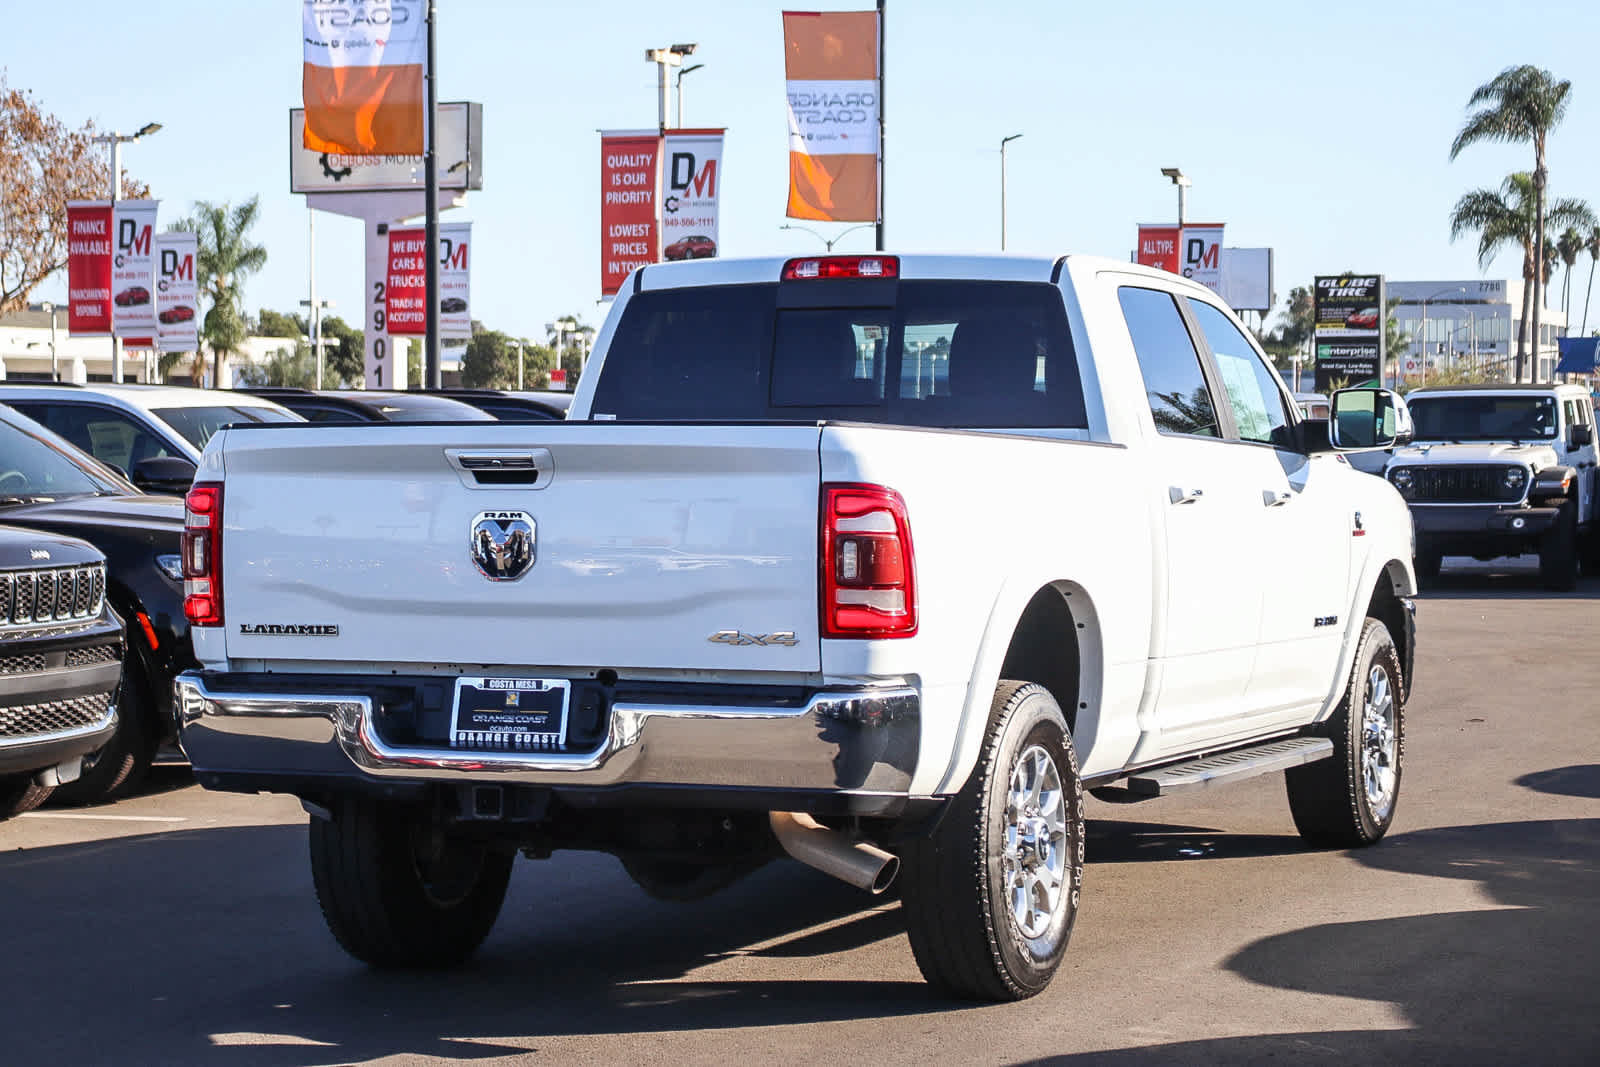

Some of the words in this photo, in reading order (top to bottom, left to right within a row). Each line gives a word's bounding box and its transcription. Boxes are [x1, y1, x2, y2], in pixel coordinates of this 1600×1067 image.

[607, 154, 652, 168] QUALITY
[612, 173, 621, 186] IS
[623, 173, 646, 185] OUR
[671, 152, 717, 198] DM
[606, 192, 652, 205] PRIORITY
[73, 220, 105, 234] FINANCE
[609, 224, 650, 237] LOWEST
[119, 219, 152, 256] DM
[392, 240, 405, 253] WE
[407, 239, 425, 253] BUY
[613, 243, 648, 255] PRICES
[1143, 240, 1155, 254] ALL
[1157, 240, 1174, 255] TYPE
[1187, 238, 1219, 269] DM
[161, 249, 193, 281] DM
[392, 257, 415, 270] CARS
[608, 262, 620, 273] IN
[390, 275, 425, 288] TRUCKS
[1328, 288, 1368, 297] TIRE
[389, 312, 424, 323] ACCEPTED
[374, 282, 385, 387] 2901
[240, 623, 339, 636] LARAMIE
[707, 630, 800, 646] 4x4
[489, 680, 514, 689] COSTA
[515, 681, 537, 690] MESA
[472, 714, 514, 723] ORANGE
[515, 715, 548, 724] COAST
[459, 732, 510, 742] ORANGE
[515, 733, 558, 743] COAST
